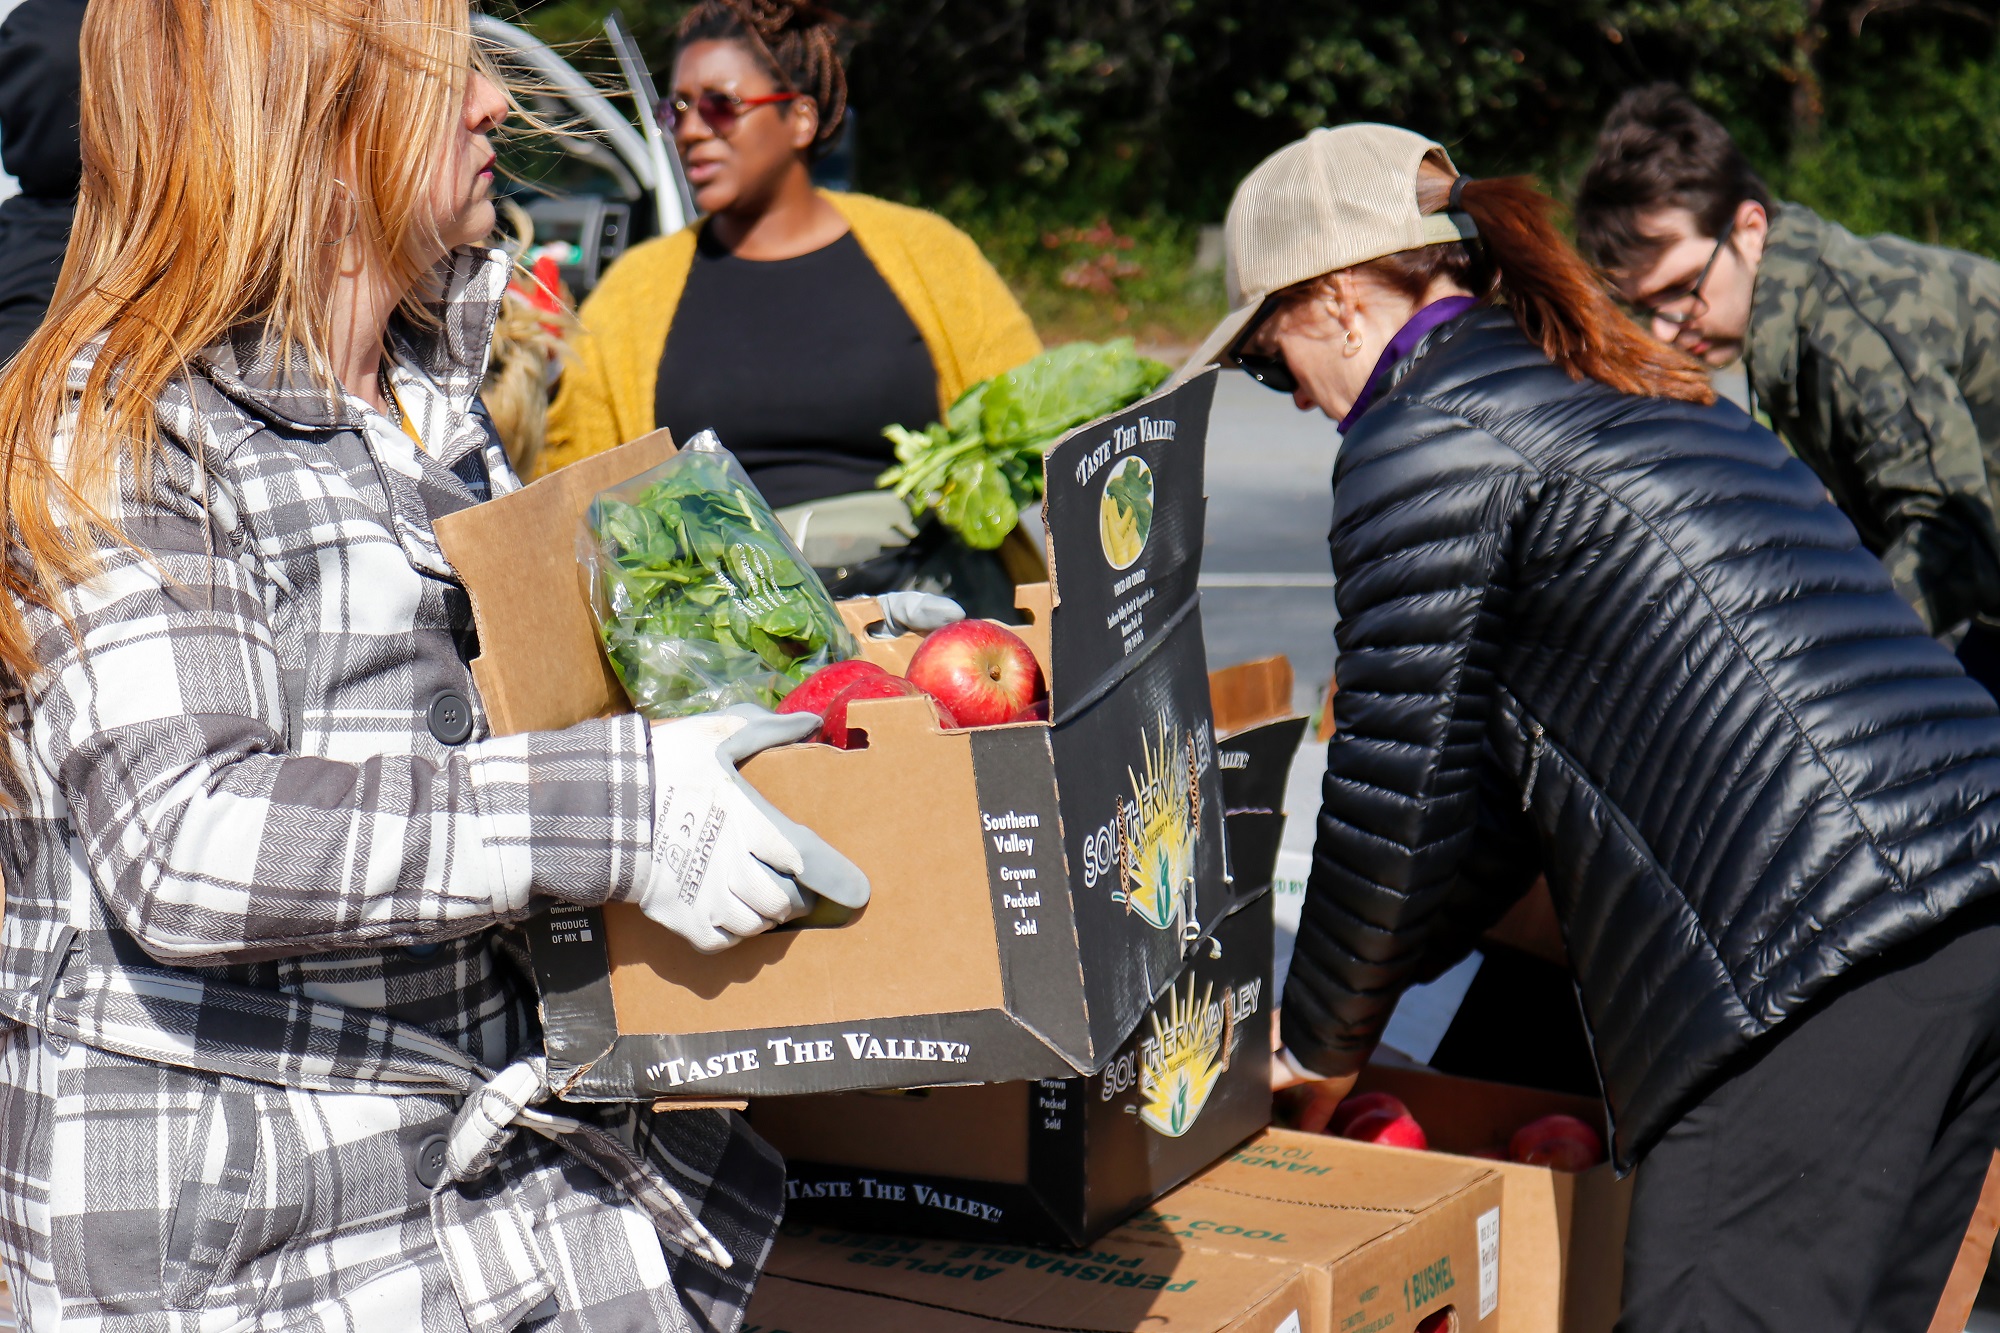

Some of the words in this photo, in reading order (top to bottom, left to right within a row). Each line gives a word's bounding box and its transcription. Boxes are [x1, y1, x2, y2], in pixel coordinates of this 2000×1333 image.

[1113, 424, 1137, 455] THE
[743, 597, 757, 610] OZ
[756, 596, 774, 611] KEEP
[983, 810, 1040, 831] Southern
[993, 833, 1035, 856] Valley
[684, 807, 726, 907] STAUFFER
[1000, 866, 1037, 881] Grown
[1003, 891, 1041, 909] Packed
[550, 919, 589, 931] PRODUCE
[1014, 919, 1038, 936] Sold
[552, 934, 563, 944] OF
[564, 933, 578, 943] MX
[645, 1049, 760, 1087] "TASTE
[767, 1036, 835, 1066] THE
[1040, 1079, 1067, 1090] Grown
[1039, 1097, 1067, 1111] Packed
[1044, 1118, 1062, 1130] Sold
[1281, 1147, 1314, 1161] TO
[859, 1177, 906, 1202] THE
[1188, 1220, 1289, 1244] COOL
[818, 1231, 922, 1255] KEEP
[847, 1252, 1005, 1282] APPLES
[947, 1243, 1198, 1292] PERISHABLE
[1403, 1278, 1411, 1313] 1
[1413, 1254, 1455, 1309] BUSHEL
